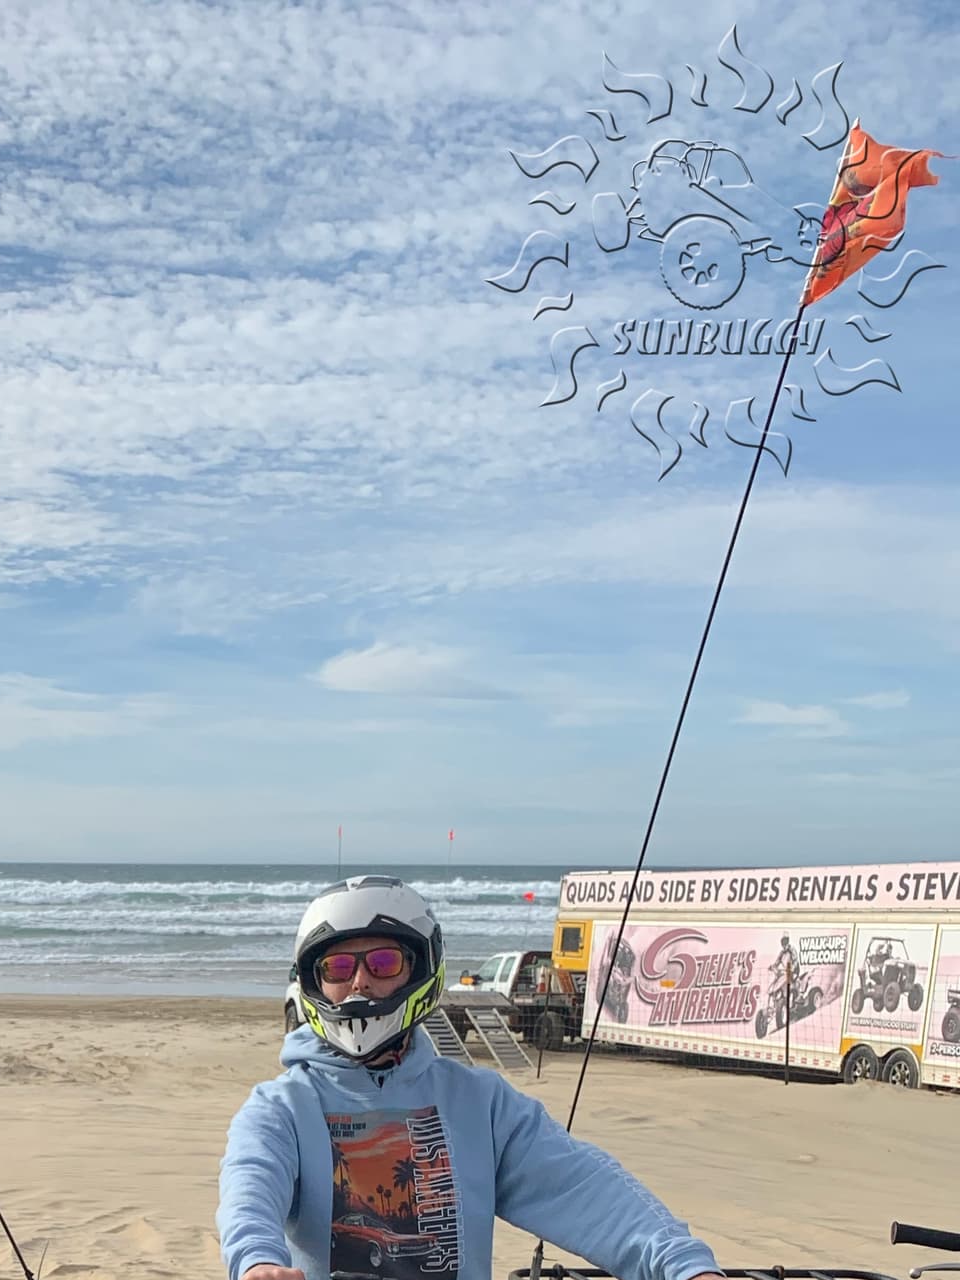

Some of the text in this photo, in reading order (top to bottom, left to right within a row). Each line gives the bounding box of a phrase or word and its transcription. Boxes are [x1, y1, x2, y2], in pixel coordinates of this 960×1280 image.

[566, 881, 616, 904] QUADS
[619, 880, 654, 902] AND
[658, 880, 696, 903] SIDE
[700, 878, 724, 902] BY
[727, 877, 781, 902] SIDES
[786, 874, 879, 901] RENTALS
[799, 935, 847, 951] WALK-UPS
[800, 950, 846, 965] WELCOME
[649, 985, 760, 1026] ATV RENTALS
[406, 1114, 455, 1163] LOS
[413, 1166, 465, 1273] ANGELES
